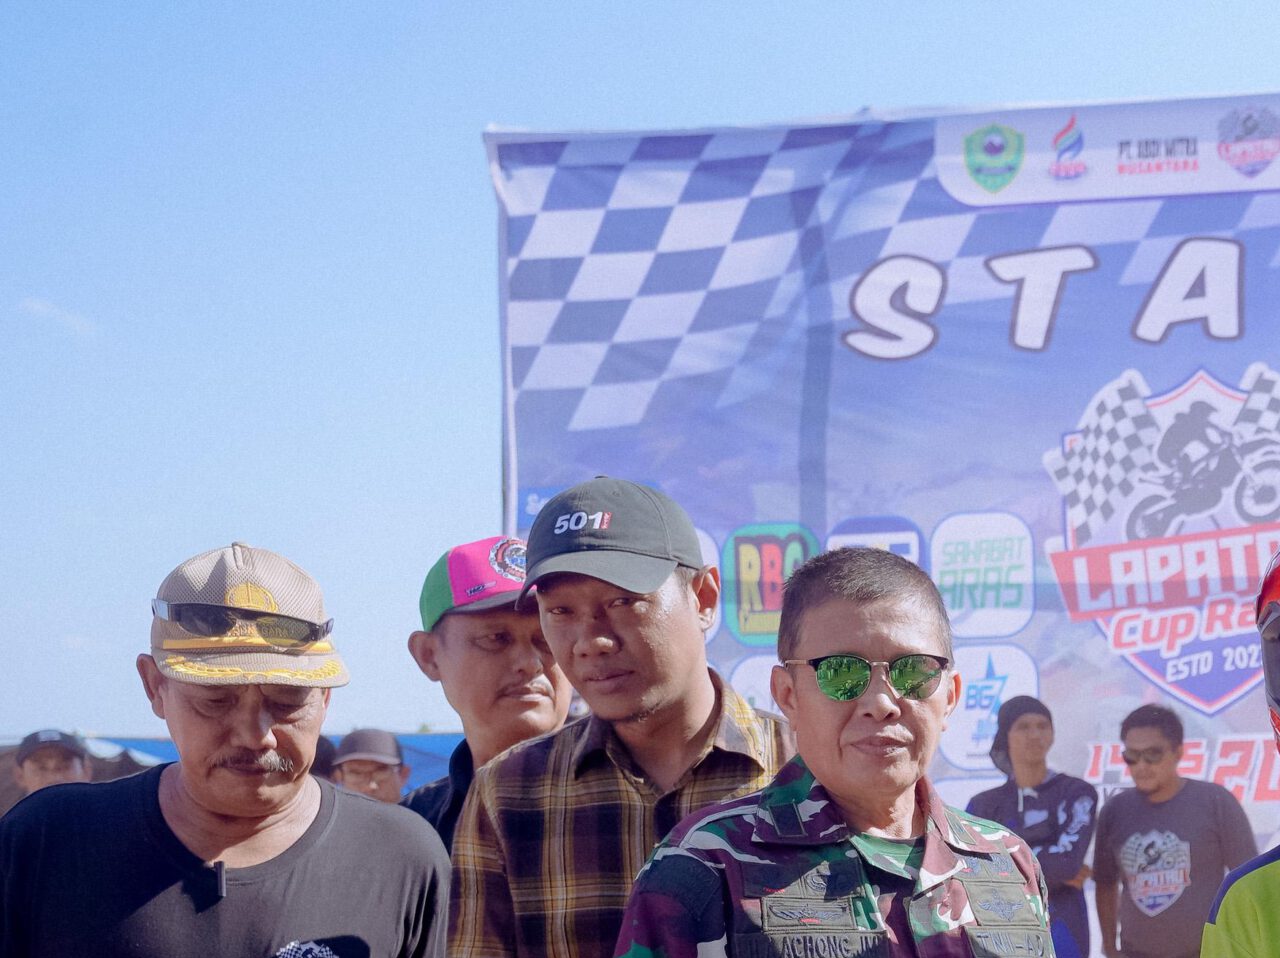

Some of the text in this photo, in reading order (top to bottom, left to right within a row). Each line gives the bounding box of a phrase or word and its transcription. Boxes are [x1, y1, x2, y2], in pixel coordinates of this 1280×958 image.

[554, 511, 604, 535] 501
[938, 565, 1024, 610] ARAS
[1110, 597, 1257, 654] Cup Ra
[1165, 643, 1262, 684] ESTD 202
[976, 932, 1045, 957] TNI-AD
